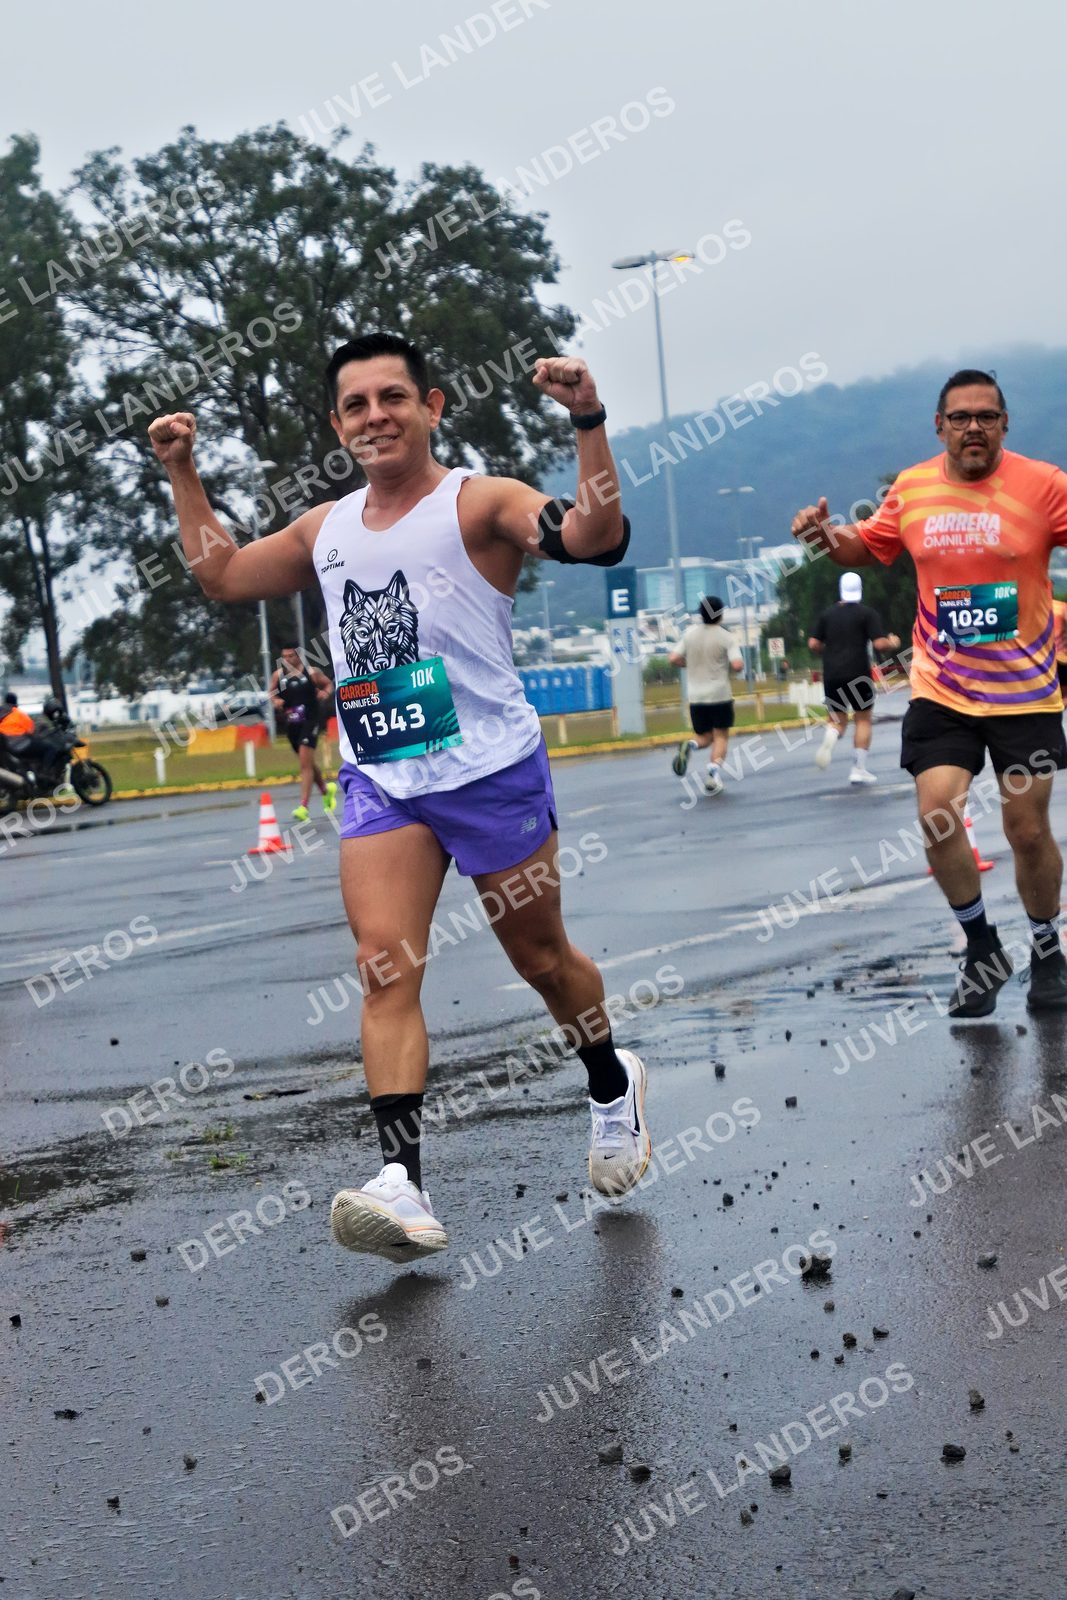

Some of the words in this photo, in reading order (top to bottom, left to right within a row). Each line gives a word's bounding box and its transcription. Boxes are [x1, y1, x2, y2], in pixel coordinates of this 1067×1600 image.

[924, 512, 1000, 535] CARRERA
[612, 588, 630, 612] E
[940, 590, 971, 600] CARRERA
[994, 587, 1011, 599] 10K
[948, 608, 998, 627] 1026
[410, 667, 435, 689] 10K
[340, 681, 378, 700] CARRERA
[359, 702, 426, 738] 1343
